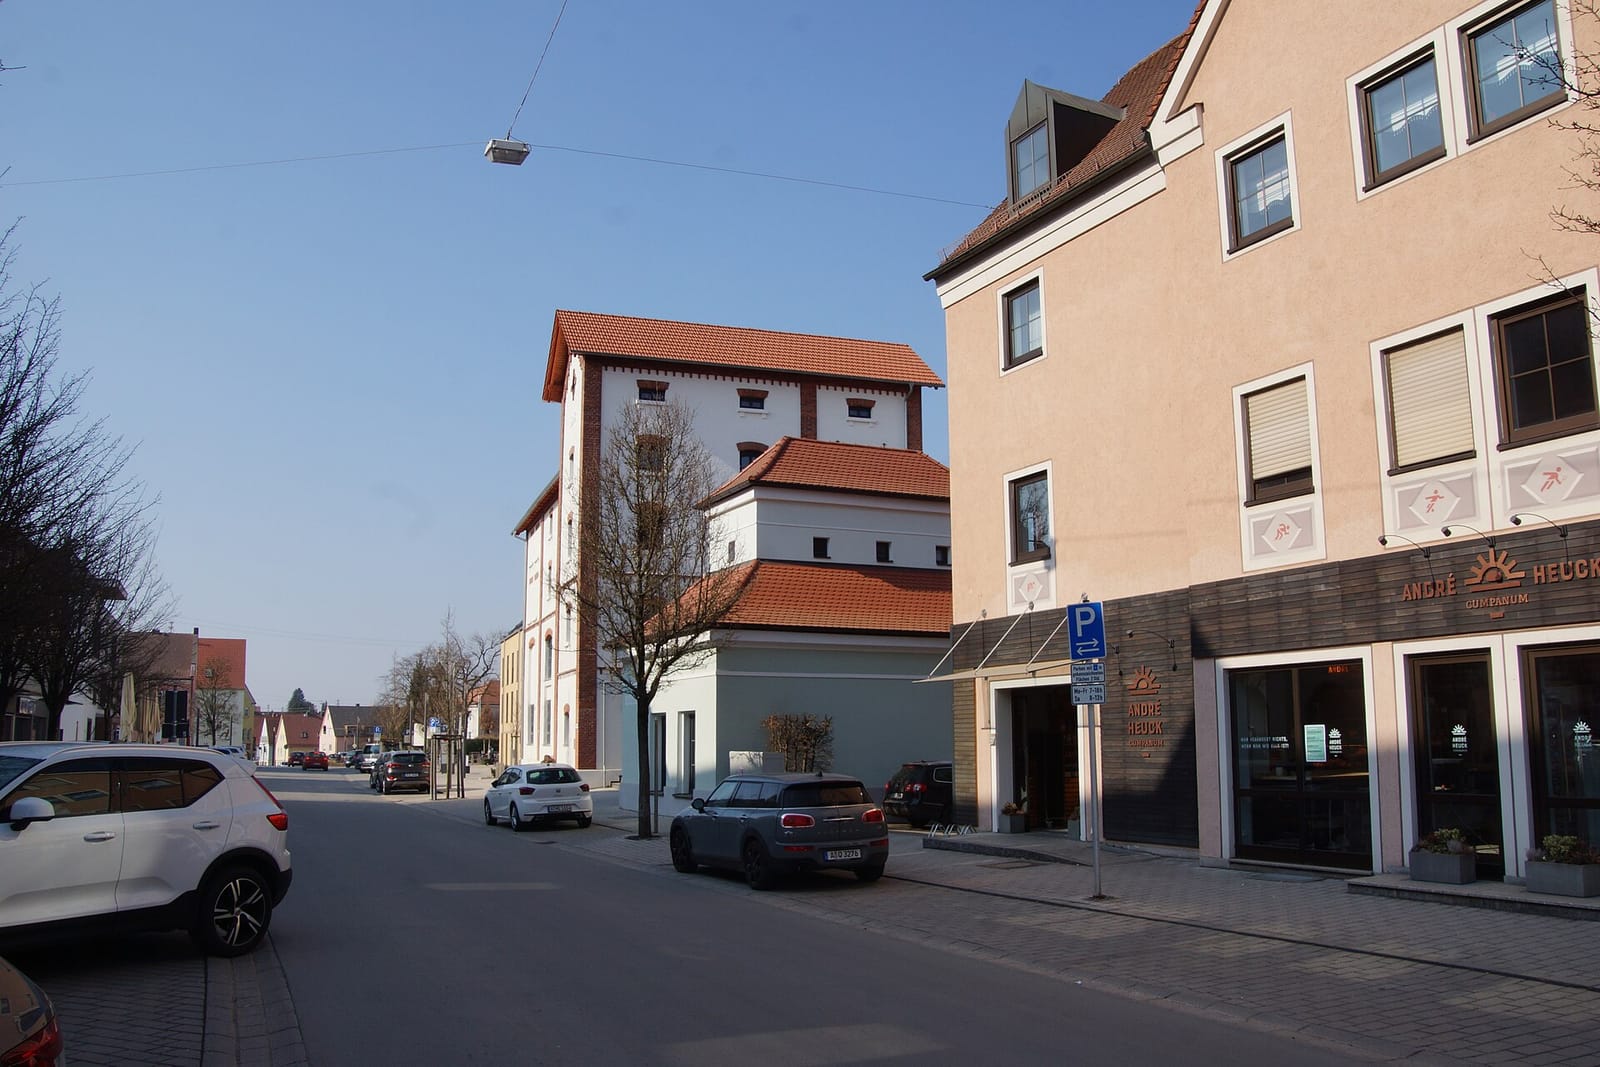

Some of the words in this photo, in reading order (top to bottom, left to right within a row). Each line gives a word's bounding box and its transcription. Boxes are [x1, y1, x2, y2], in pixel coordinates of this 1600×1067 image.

[1403, 573, 1457, 600] ANDRÉ
[1466, 593, 1528, 609] CUMPANUM
[1075, 607, 1096, 638] P
[1128, 699, 1161, 716] ANDRÉ
[1128, 720, 1163, 735] HEUCK
